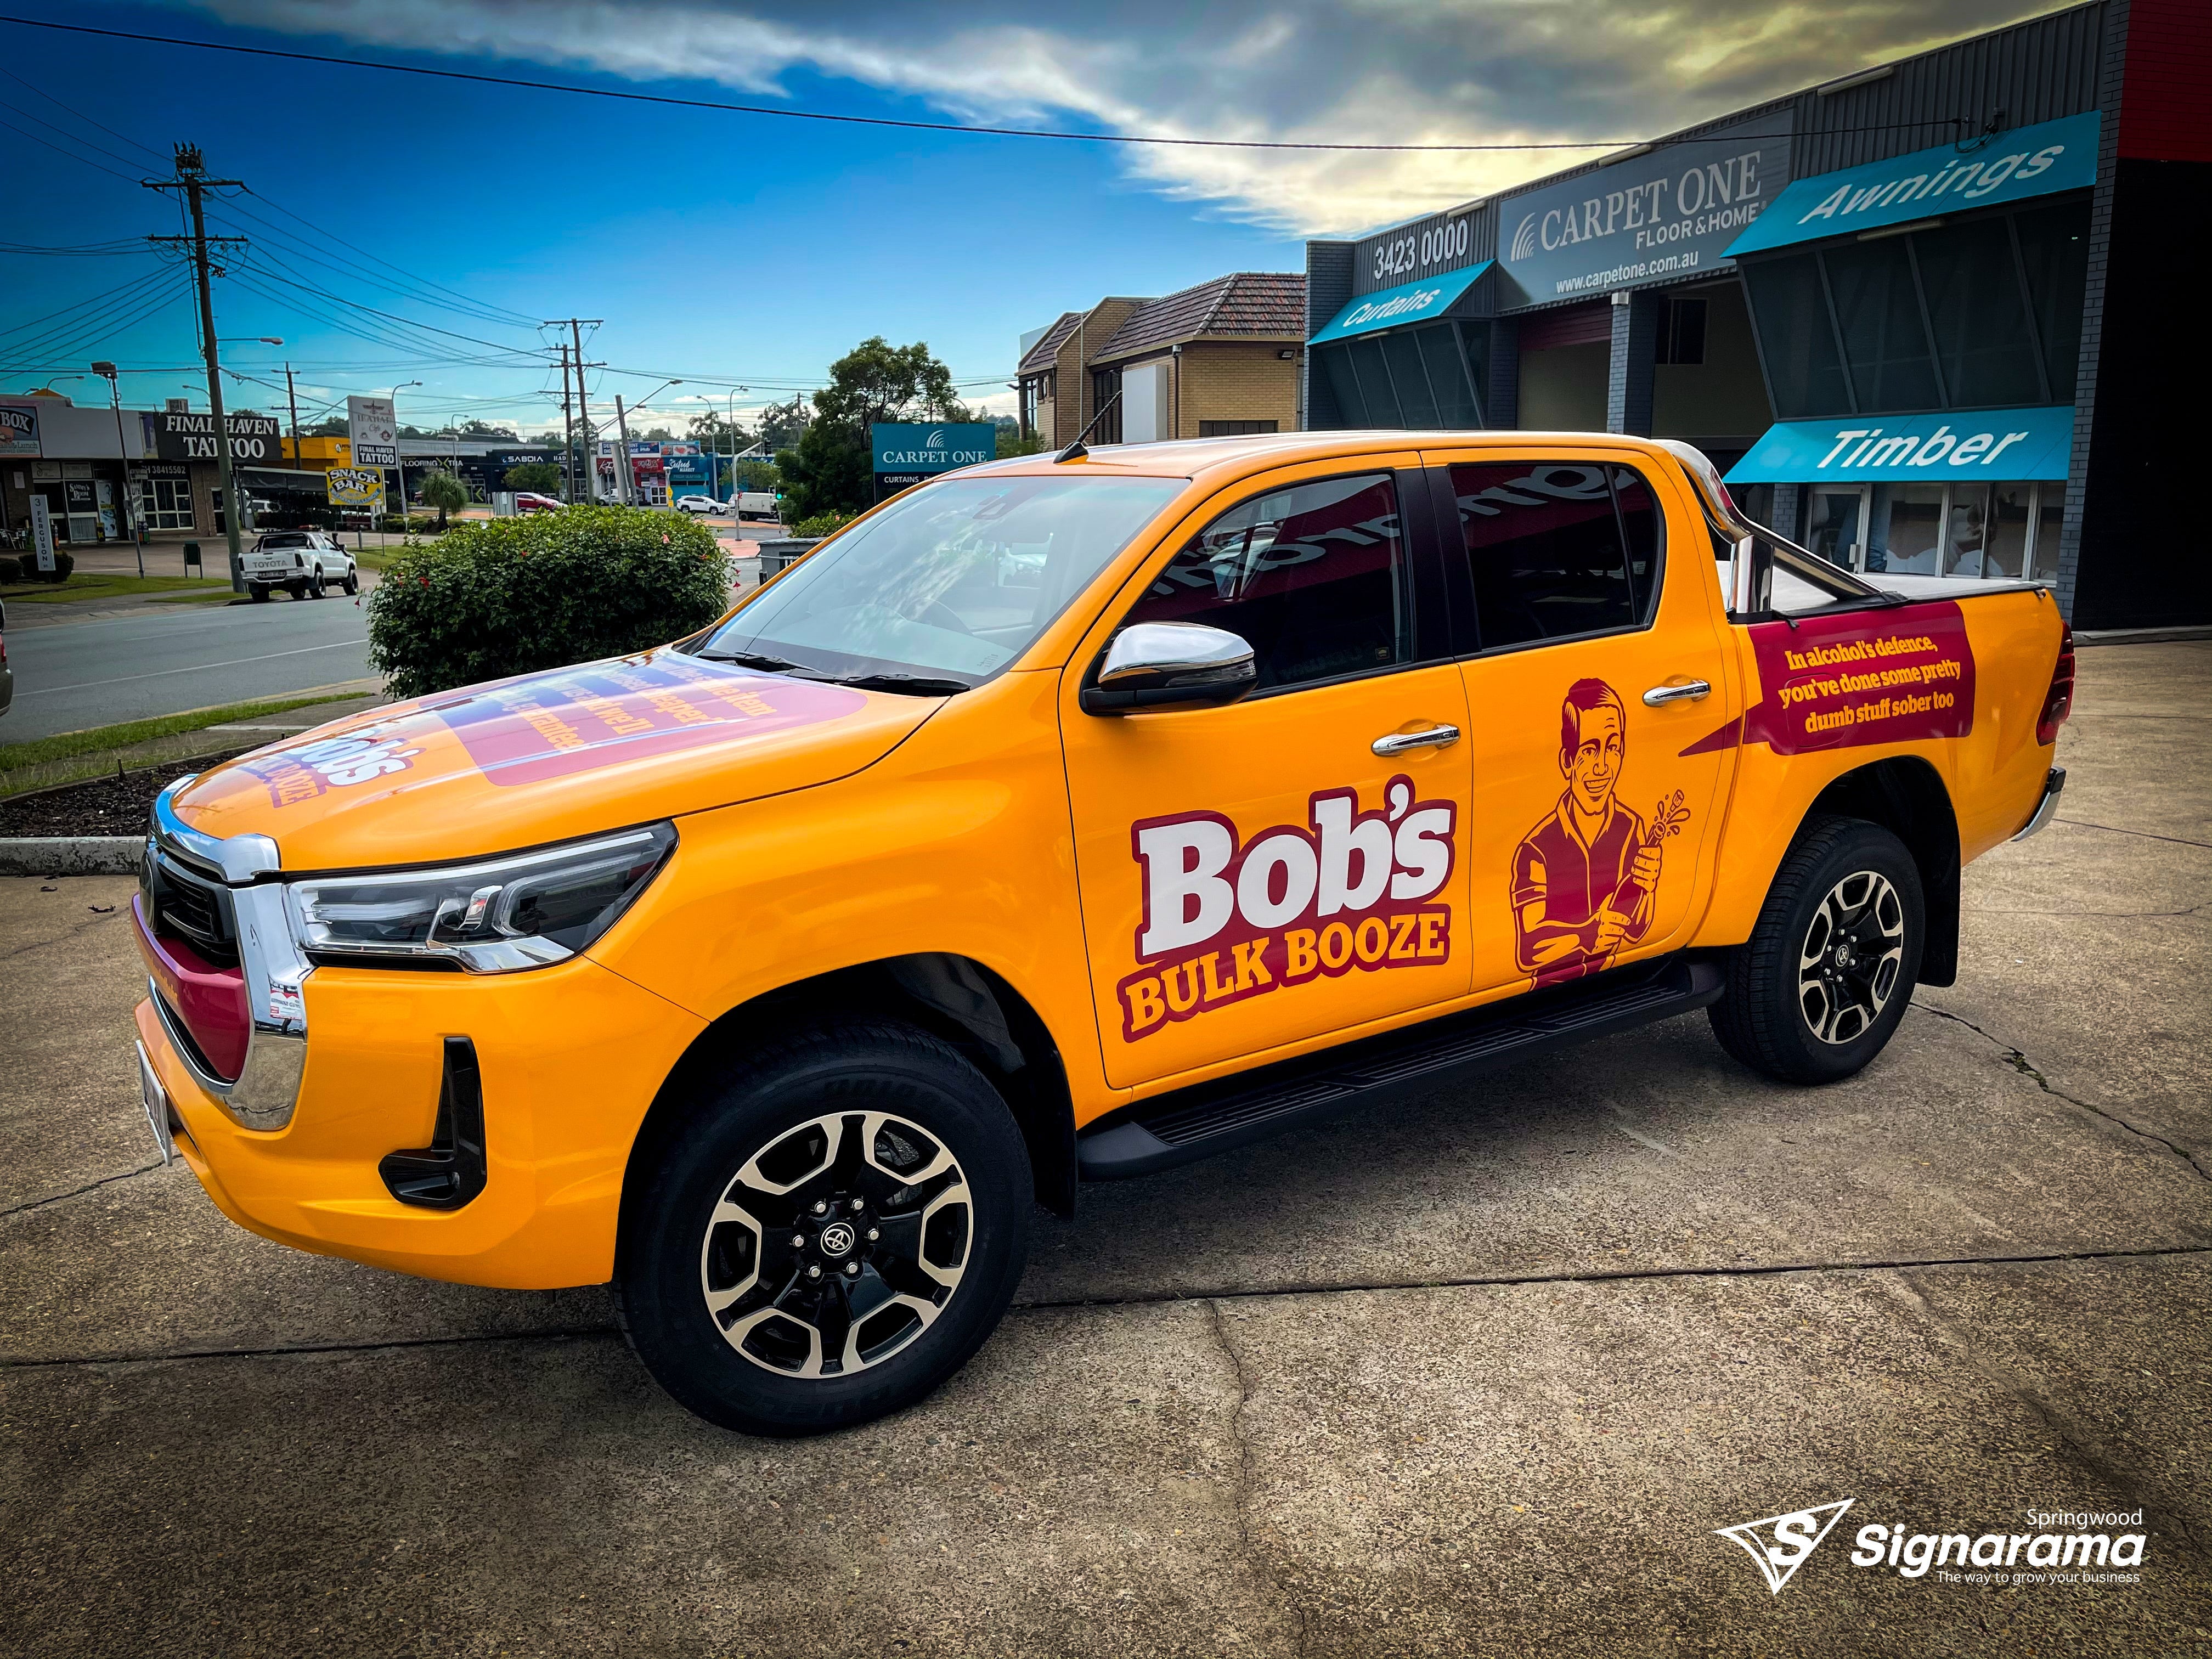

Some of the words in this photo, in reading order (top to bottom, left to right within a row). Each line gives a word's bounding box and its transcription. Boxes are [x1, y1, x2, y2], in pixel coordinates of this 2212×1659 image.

[1541, 178, 1668, 251] CARPET
[1677, 151, 1761, 216] ONE
[1797, 145, 2065, 224] Awnings
[1636, 221, 1692, 250] FLOOR
[1695, 216, 1707, 235] &
[1708, 202, 1759, 233] HOME
[1374, 235, 1416, 280] 3423
[1420, 218, 1469, 267] 0000
[1556, 250, 1699, 294] www.carpetone.com.au
[1342, 289, 1441, 328] Curtains
[0, 411, 30, 432] BOX
[166, 415, 215, 433] FINAL
[224, 415, 274, 435] HAVEN
[360, 453, 394, 464] TATTOO
[883, 451, 947, 463] CARPET
[952, 451, 987, 463] ONE
[1816, 426, 2030, 468] Timber
[151, 465, 186, 474] 38415502
[330, 469, 377, 483] SNACK
[334, 479, 366, 493] BAR
[35, 498, 41, 506] 3
[252, 560, 288, 568] TOYOTA
[1785, 651, 1808, 670] In
[1808, 640, 1876, 667] alcohol's
[1875, 636, 1938, 657] defence,
[1778, 679, 1839, 710] you've
[1839, 674, 1881, 693] done
[1880, 666, 1921, 686] some
[1920, 659, 1961, 684] pretty
[594, 707, 655, 735] we'll
[721, 691, 778, 716] item
[1805, 706, 1854, 733] dumb
[1856, 698, 1891, 723] stuff
[1892, 695, 1932, 717] sober
[1933, 691, 1954, 710] too
[264, 763, 319, 805] BOOZE
[1138, 783, 1452, 957] Bob's
[1125, 936, 1274, 1034] BULK
[1284, 912, 1447, 978] BOOZE
